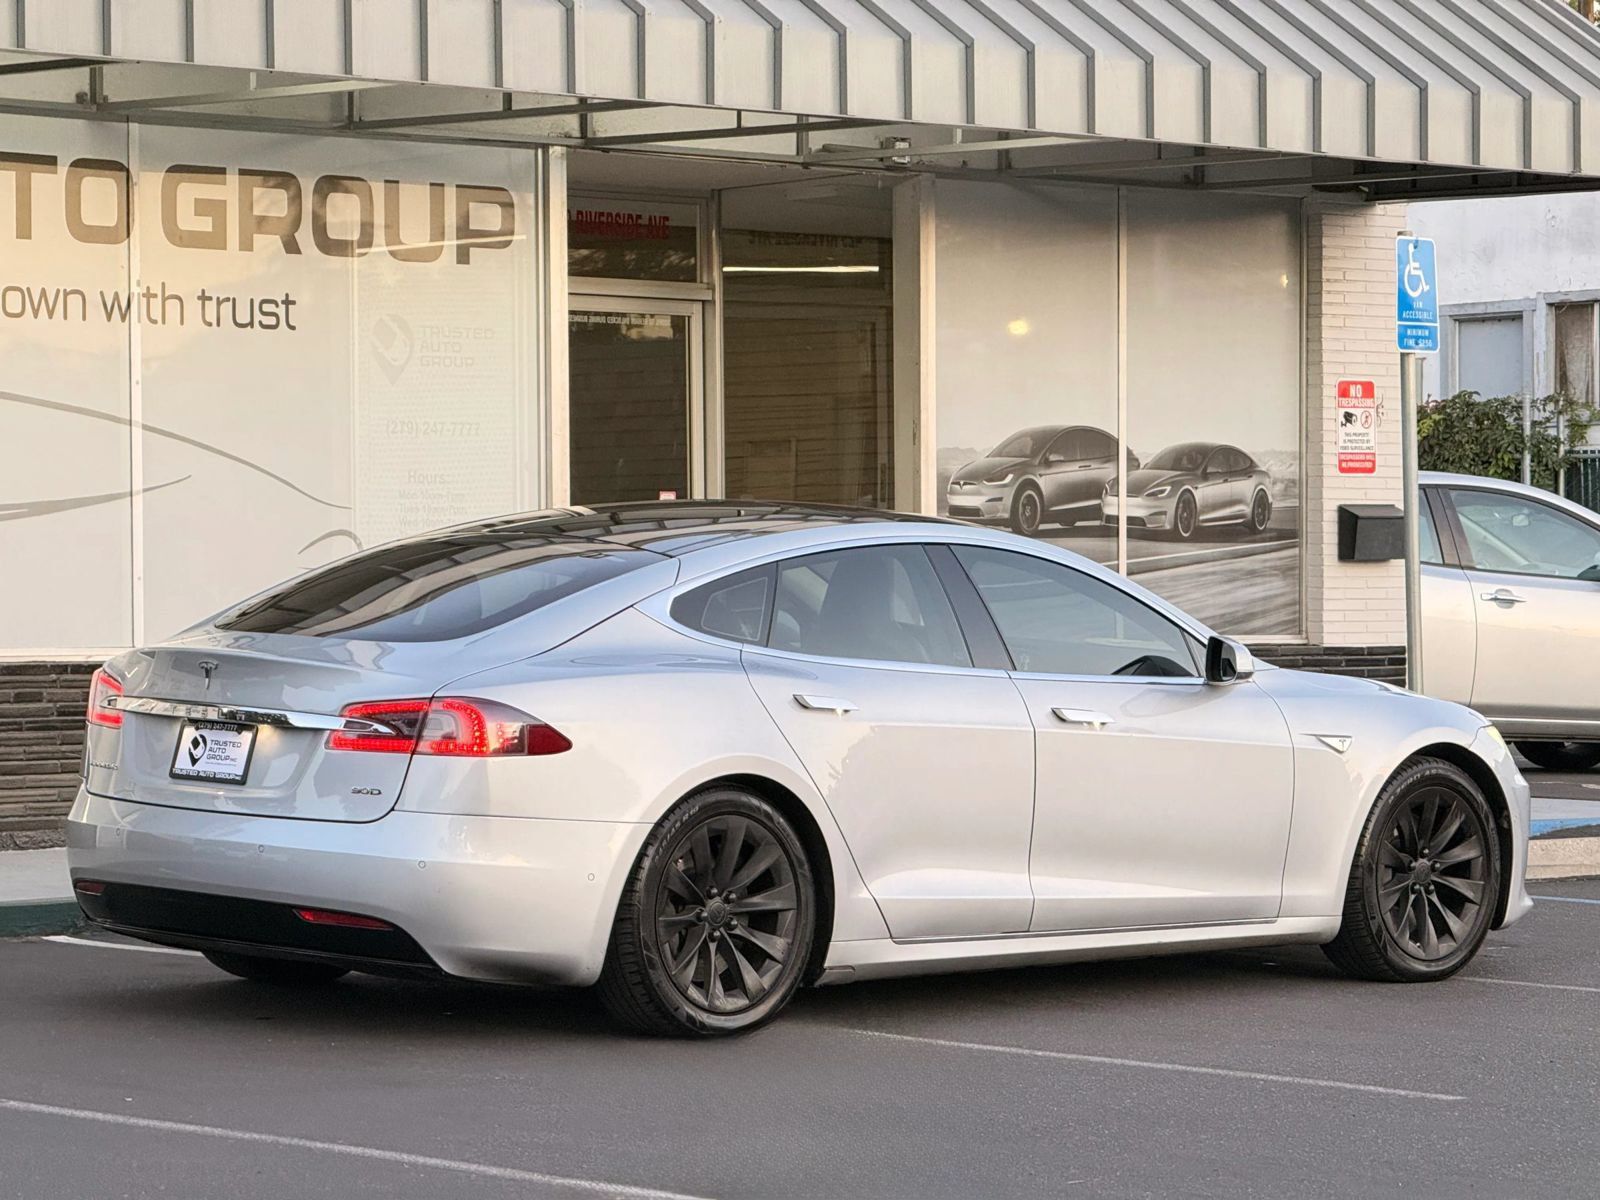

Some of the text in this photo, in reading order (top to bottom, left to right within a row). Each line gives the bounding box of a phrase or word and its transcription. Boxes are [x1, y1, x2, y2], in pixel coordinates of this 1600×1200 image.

[161, 163, 515, 265] GROUP
[647, 215, 670, 239] AVE
[99, 281, 184, 326] with
[196, 288, 297, 331] trust
[1402, 310, 1433, 320] ACCESSIBLE
[420, 325, 494, 339] TRUSTED
[1407, 328, 1429, 337] MINIMUM
[420, 341, 462, 353] AUTO
[420, 355, 475, 368] GROUP
[1349, 384, 1363, 398] NO
[1338, 398, 1375, 408] TRESPASSING
[210, 739, 242, 748] TRUSTED
[172, 768, 198, 776] TRUSTED
[199, 770, 214, 778] AUTO
[215, 772, 235, 780] GROUP
